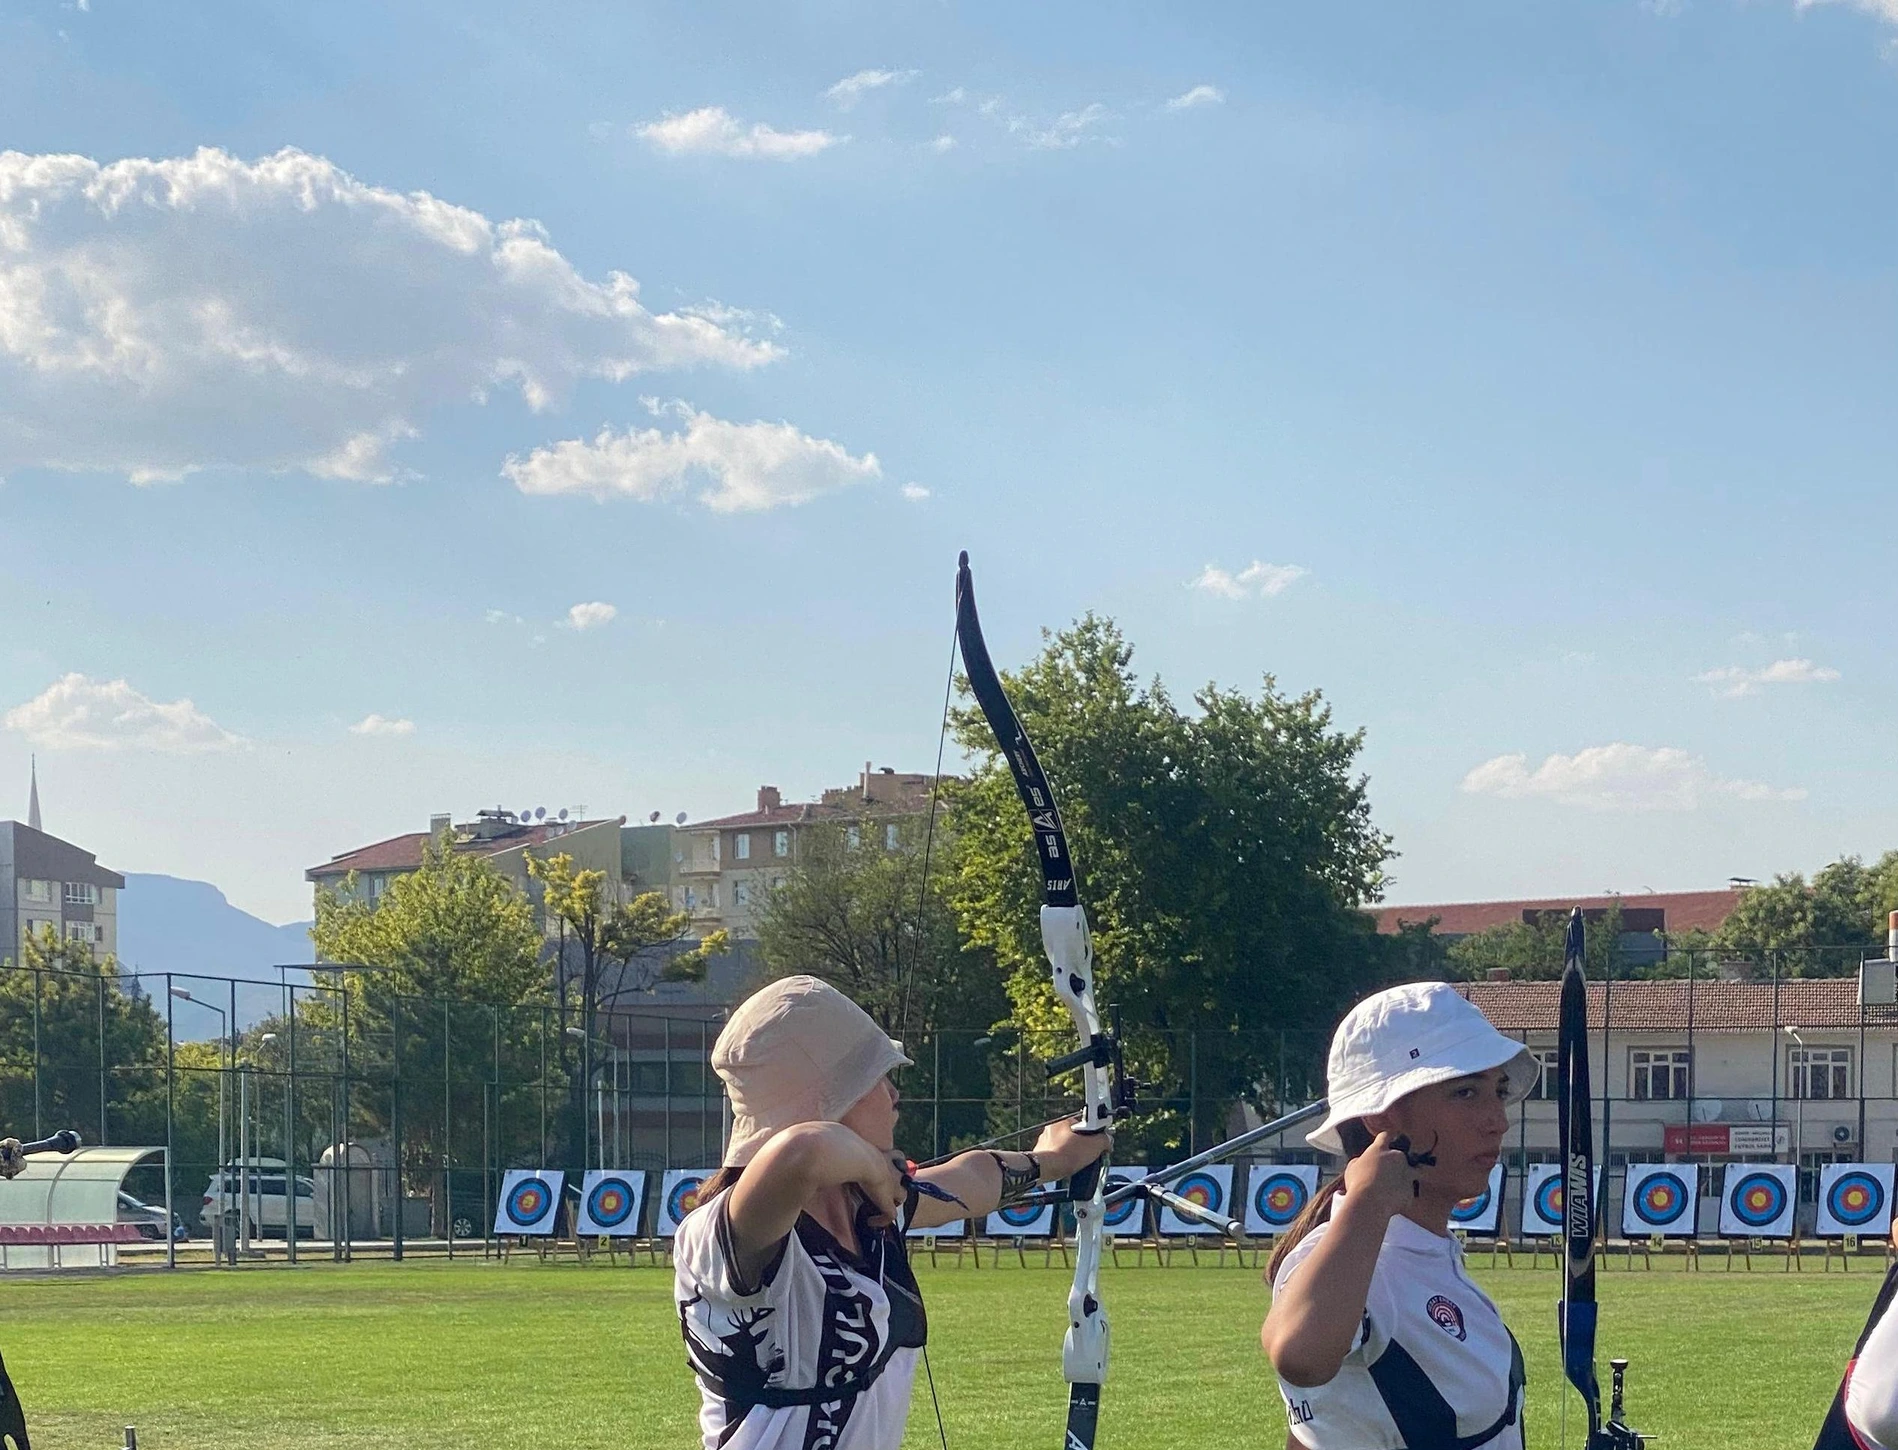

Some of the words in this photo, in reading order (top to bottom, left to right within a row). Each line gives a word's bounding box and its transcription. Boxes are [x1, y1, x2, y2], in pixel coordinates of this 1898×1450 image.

[1046, 878, 1072, 891] ARIS
[1569, 1152, 1589, 1238] WIAWIS
[600, 1236, 607, 1246] 2
[925, 1236, 933, 1247] 6
[1187, 1235, 1196, 1246] 9
[1653, 1235, 1663, 1247] 14
[1750, 1238, 1761, 1249] 15
[1845, 1236, 1856, 1247] 16
